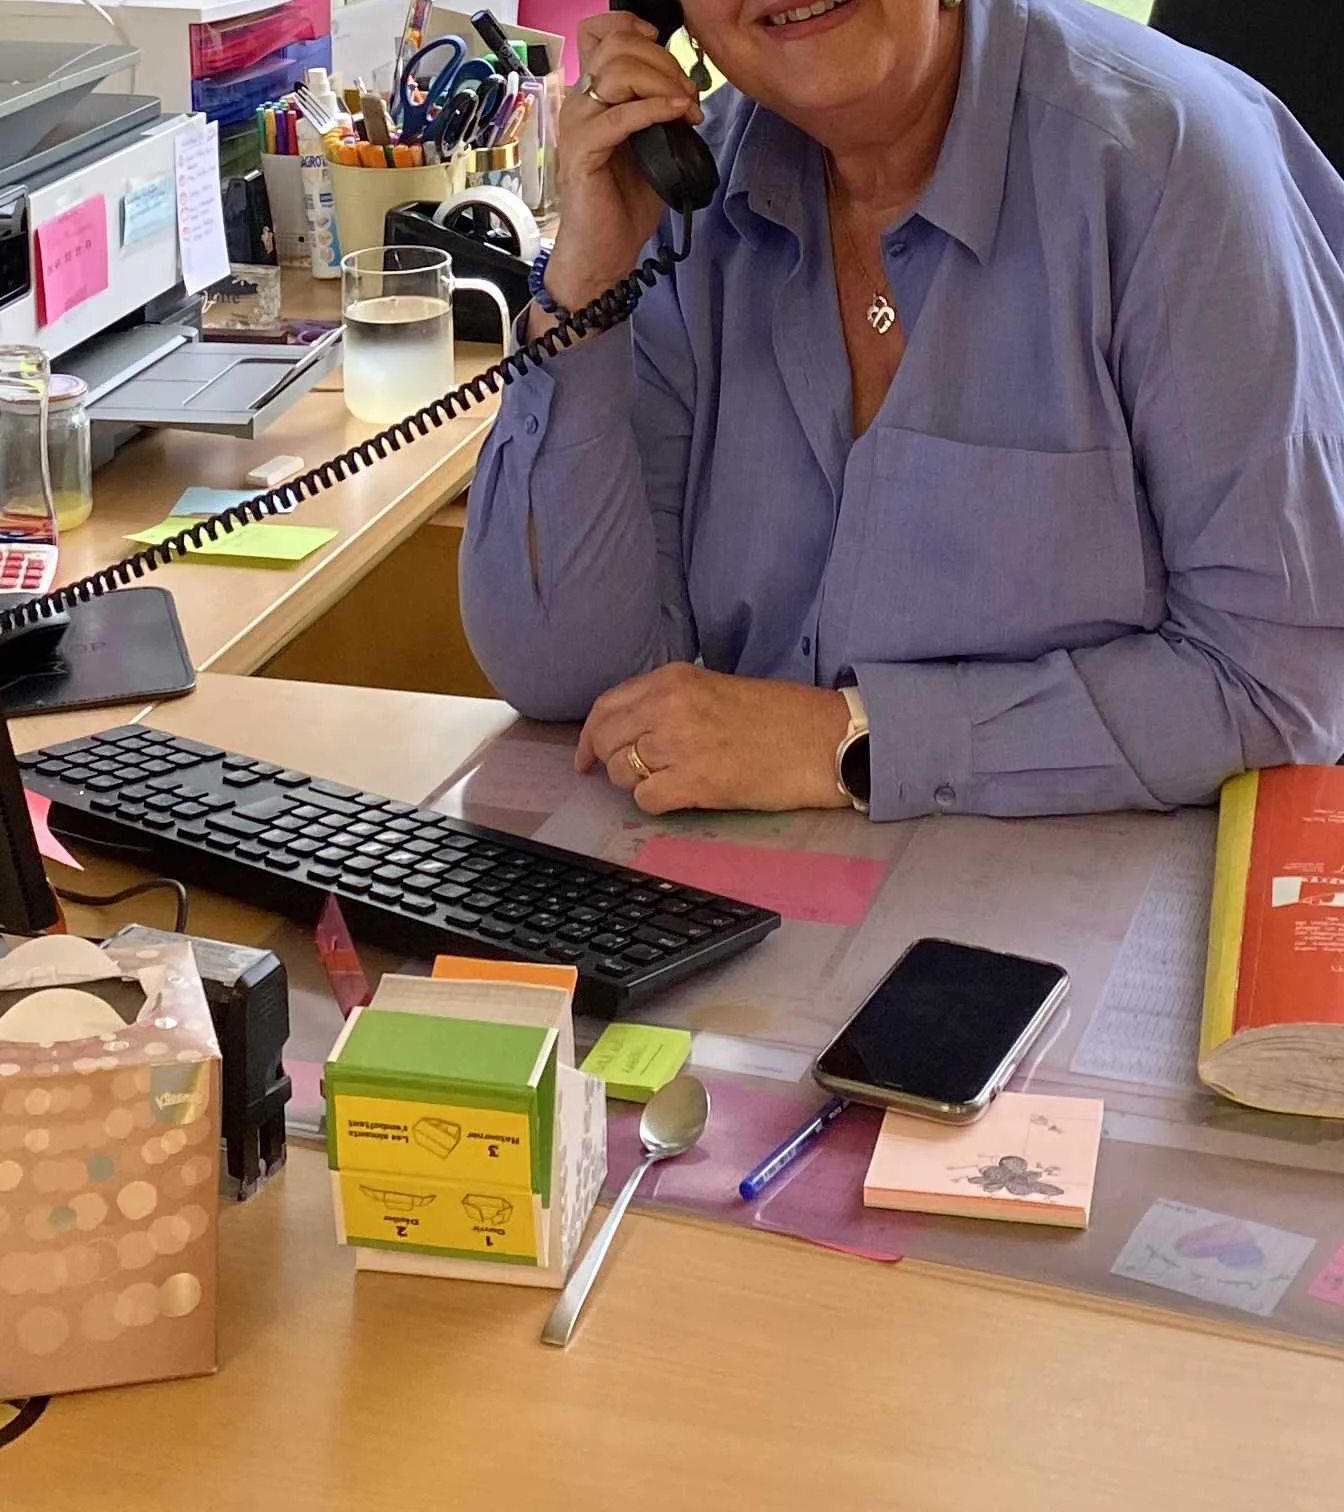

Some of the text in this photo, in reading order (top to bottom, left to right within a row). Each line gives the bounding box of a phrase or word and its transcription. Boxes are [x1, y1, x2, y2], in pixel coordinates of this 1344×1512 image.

[466, 1131, 520, 1145] Retourner
[487, 1144, 499, 1157] 3
[395, 1225, 408, 1237] 2
[472, 1226, 506, 1236] Ouvrir
[485, 1235, 494, 1247] 1
